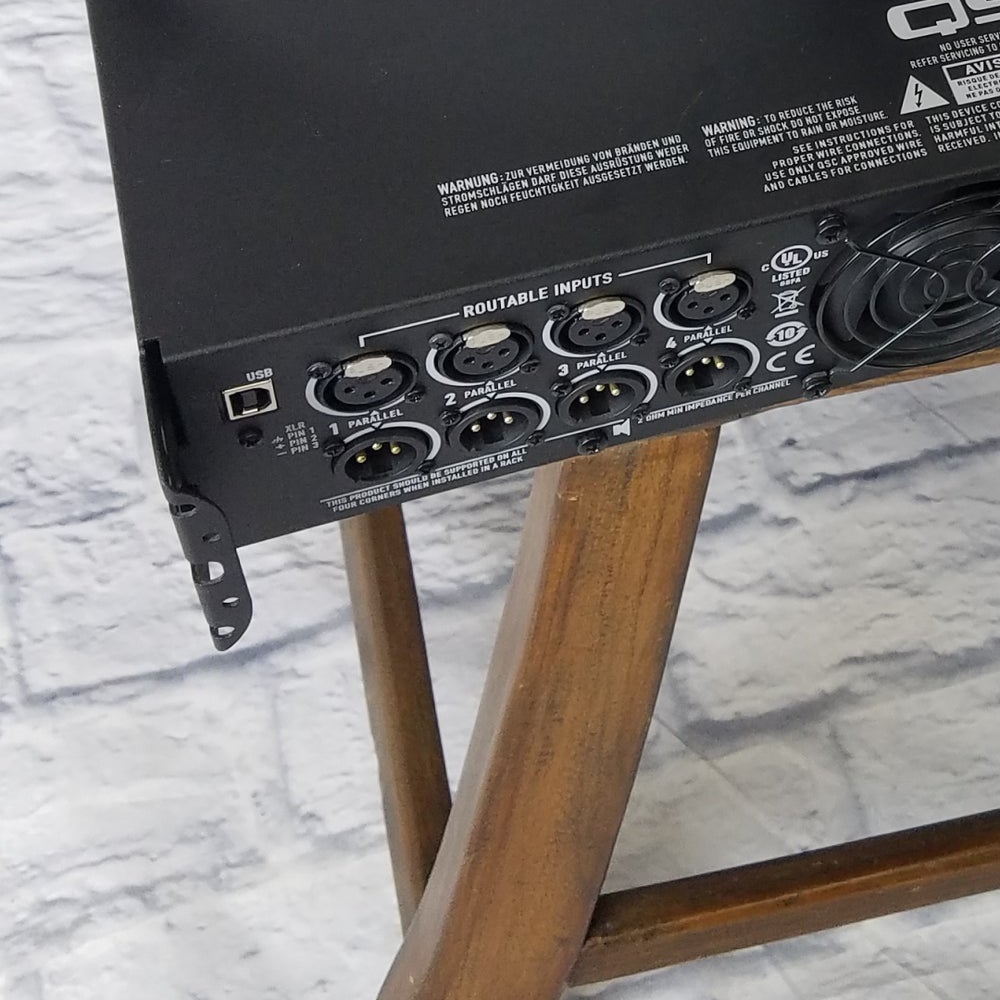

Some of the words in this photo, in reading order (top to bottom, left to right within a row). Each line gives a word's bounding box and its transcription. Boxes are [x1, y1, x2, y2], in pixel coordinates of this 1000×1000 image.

[909, 56, 939, 68] REFER
[939, 46, 984, 62] SERVICING
[985, 42, 998, 52] TO
[939, 42, 952, 52] NO
[953, 37, 977, 49] USER
[701, 115, 760, 136] WARNING:
[763, 113, 776, 123] TO
[778, 104, 814, 120] REDUCE
[815, 100, 834, 112] THE
[835, 95, 857, 108] RISK
[704, 136, 716, 147] OF
[718, 131, 741, 144] FIRE
[742, 128, 756, 139] OR
[757, 121, 789, 135] SHOCK
[790, 118, 803, 128] DO
[804, 113, 823, 125] NOT
[825, 105, 860, 120] EXPOSE
[925, 112, 950, 124] THIS
[951, 103, 988, 118] DEVICE
[929, 124, 941, 133] IS
[942, 113, 986, 130] SUBJECT
[707, 145, 730, 157] THIS
[731, 132, 784, 152] EQUIPMENT
[785, 129, 799, 140] TO
[800, 124, 823, 137] RAIN
[824, 121, 838, 131] OR
[839, 110, 888, 128] MOISTURE.
[792, 142, 813, 154] SEE
[814, 125, 891, 149] INSTRUCTIONS
[892, 120, 914, 131] FOR
[933, 126, 983, 143] HARMFUL
[504, 168, 525, 181] ZUR
[526, 154, 590, 176] VERMEIDUNG
[592, 149, 612, 161] VON
[614, 139, 659, 156] BRÄNDEN
[661, 134, 681, 146] UND
[764, 169, 786, 181] USE
[788, 163, 814, 176] ONLY
[816, 157, 838, 169] QSC
[840, 145, 894, 164] APPROVED
[895, 138, 923, 151] WIRE
[772, 153, 814, 169] PROPER
[815, 146, 843, 159] WIRE
[845, 129, 921, 152] CONNECTIONS.
[441, 179, 528, 206] STROMSCHLÄGEN
[530, 172, 556, 186] DARF
[559, 165, 588, 180] DIESE
[590, 151, 653, 173] AUSRÜSTUNG
[655, 143, 689, 158] WEDER
[764, 180, 785, 192] AND
[787, 170, 828, 186] CABLES
[830, 165, 852, 177] FOR
[853, 148, 927, 171] CONNECTIONS
[444, 201, 478, 217] REGEN
[480, 194, 508, 209] NOCH
[510, 178, 579, 202] FEUCHTIGKEIT
[583, 164, 642, 186] AUSGESETZT
[644, 155, 687, 171] WERDEN.
[771, 267, 811, 283] LISTED
[463, 287, 548, 317] ROUTABLE
[554, 272, 612, 296] INPUTS
[665, 337, 678, 349] 4
[683, 325, 733, 343] PARALLEL
[246, 368, 273, 382] USB
[557, 363, 569, 377] 3
[576, 352, 627, 370] PARALLEL
[444, 392, 457, 406] 2
[464, 379, 517, 399] PARALLEL
[284, 421, 307, 434] XLR
[287, 430, 306, 440] PIN
[328, 422, 340, 436] 1
[347, 408, 404, 429] PARALLEL
[289, 438, 308, 448] PIN
[311, 434, 318, 442] 2
[291, 445, 309, 455] PIN
[312, 441, 319, 449] 3
